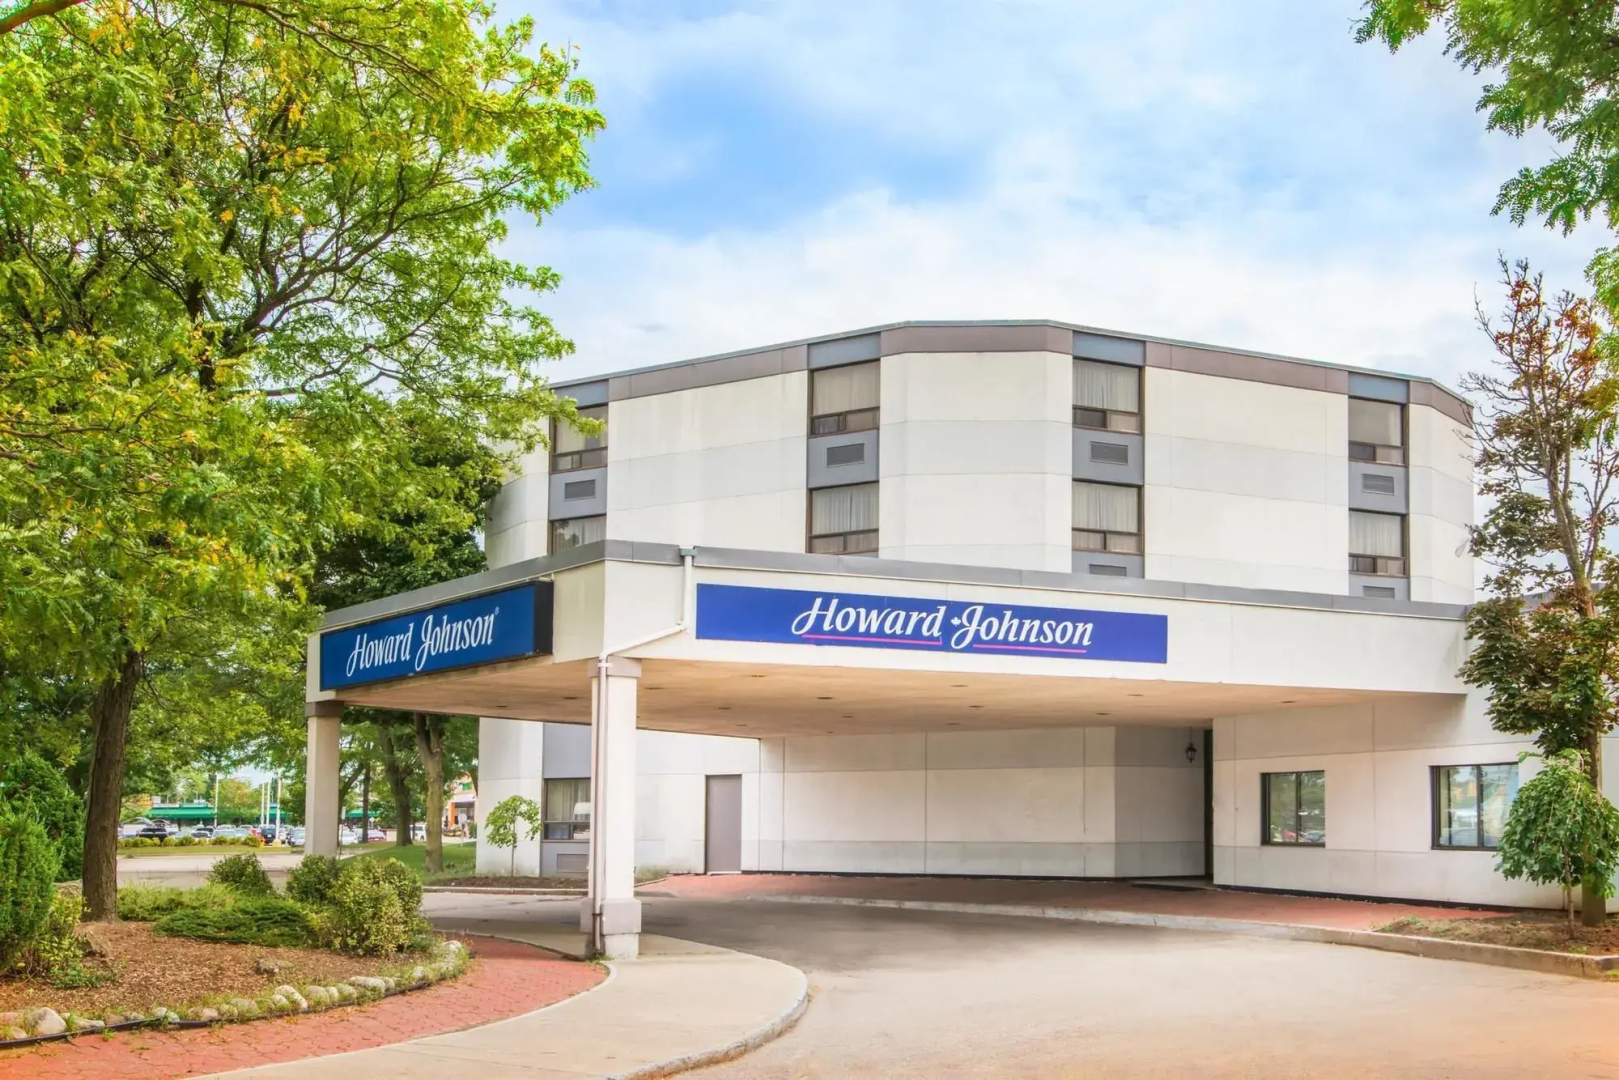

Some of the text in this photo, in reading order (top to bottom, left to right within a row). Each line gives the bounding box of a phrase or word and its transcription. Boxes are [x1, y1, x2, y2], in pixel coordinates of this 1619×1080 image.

[346, 612, 495, 677] Howard Johnson
[791, 597, 1094, 649] Howard Johnson
